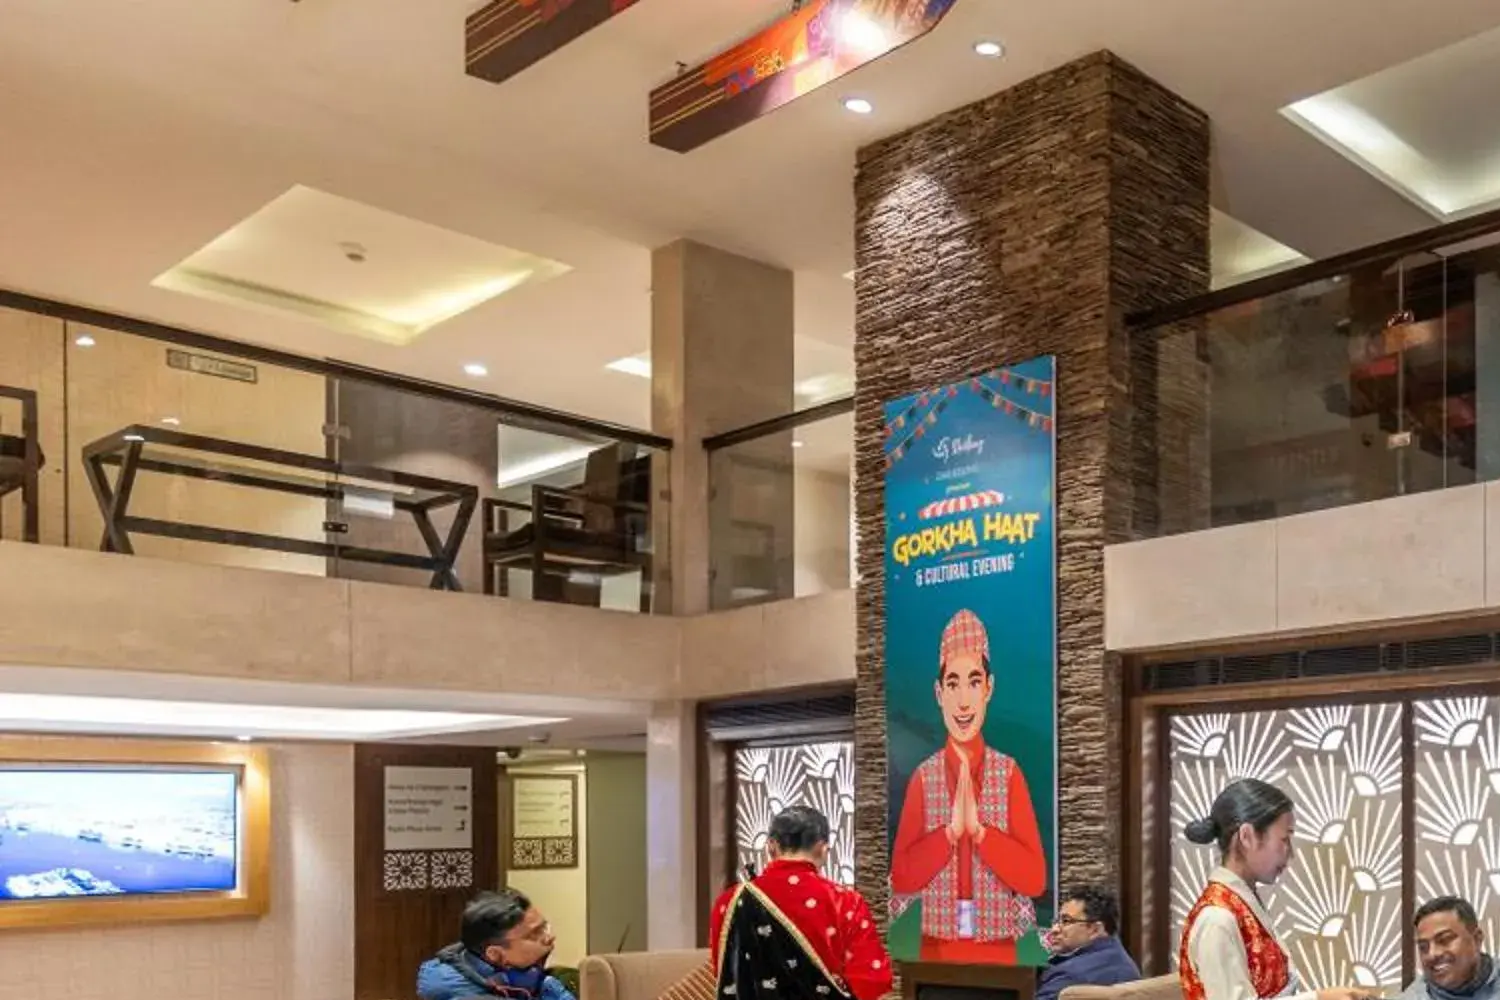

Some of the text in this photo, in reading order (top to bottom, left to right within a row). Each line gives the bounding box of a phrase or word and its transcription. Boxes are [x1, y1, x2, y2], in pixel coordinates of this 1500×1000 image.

[892, 511, 1040, 566] GORKHA HAAT
[972, 552, 1015, 577] EVENING
